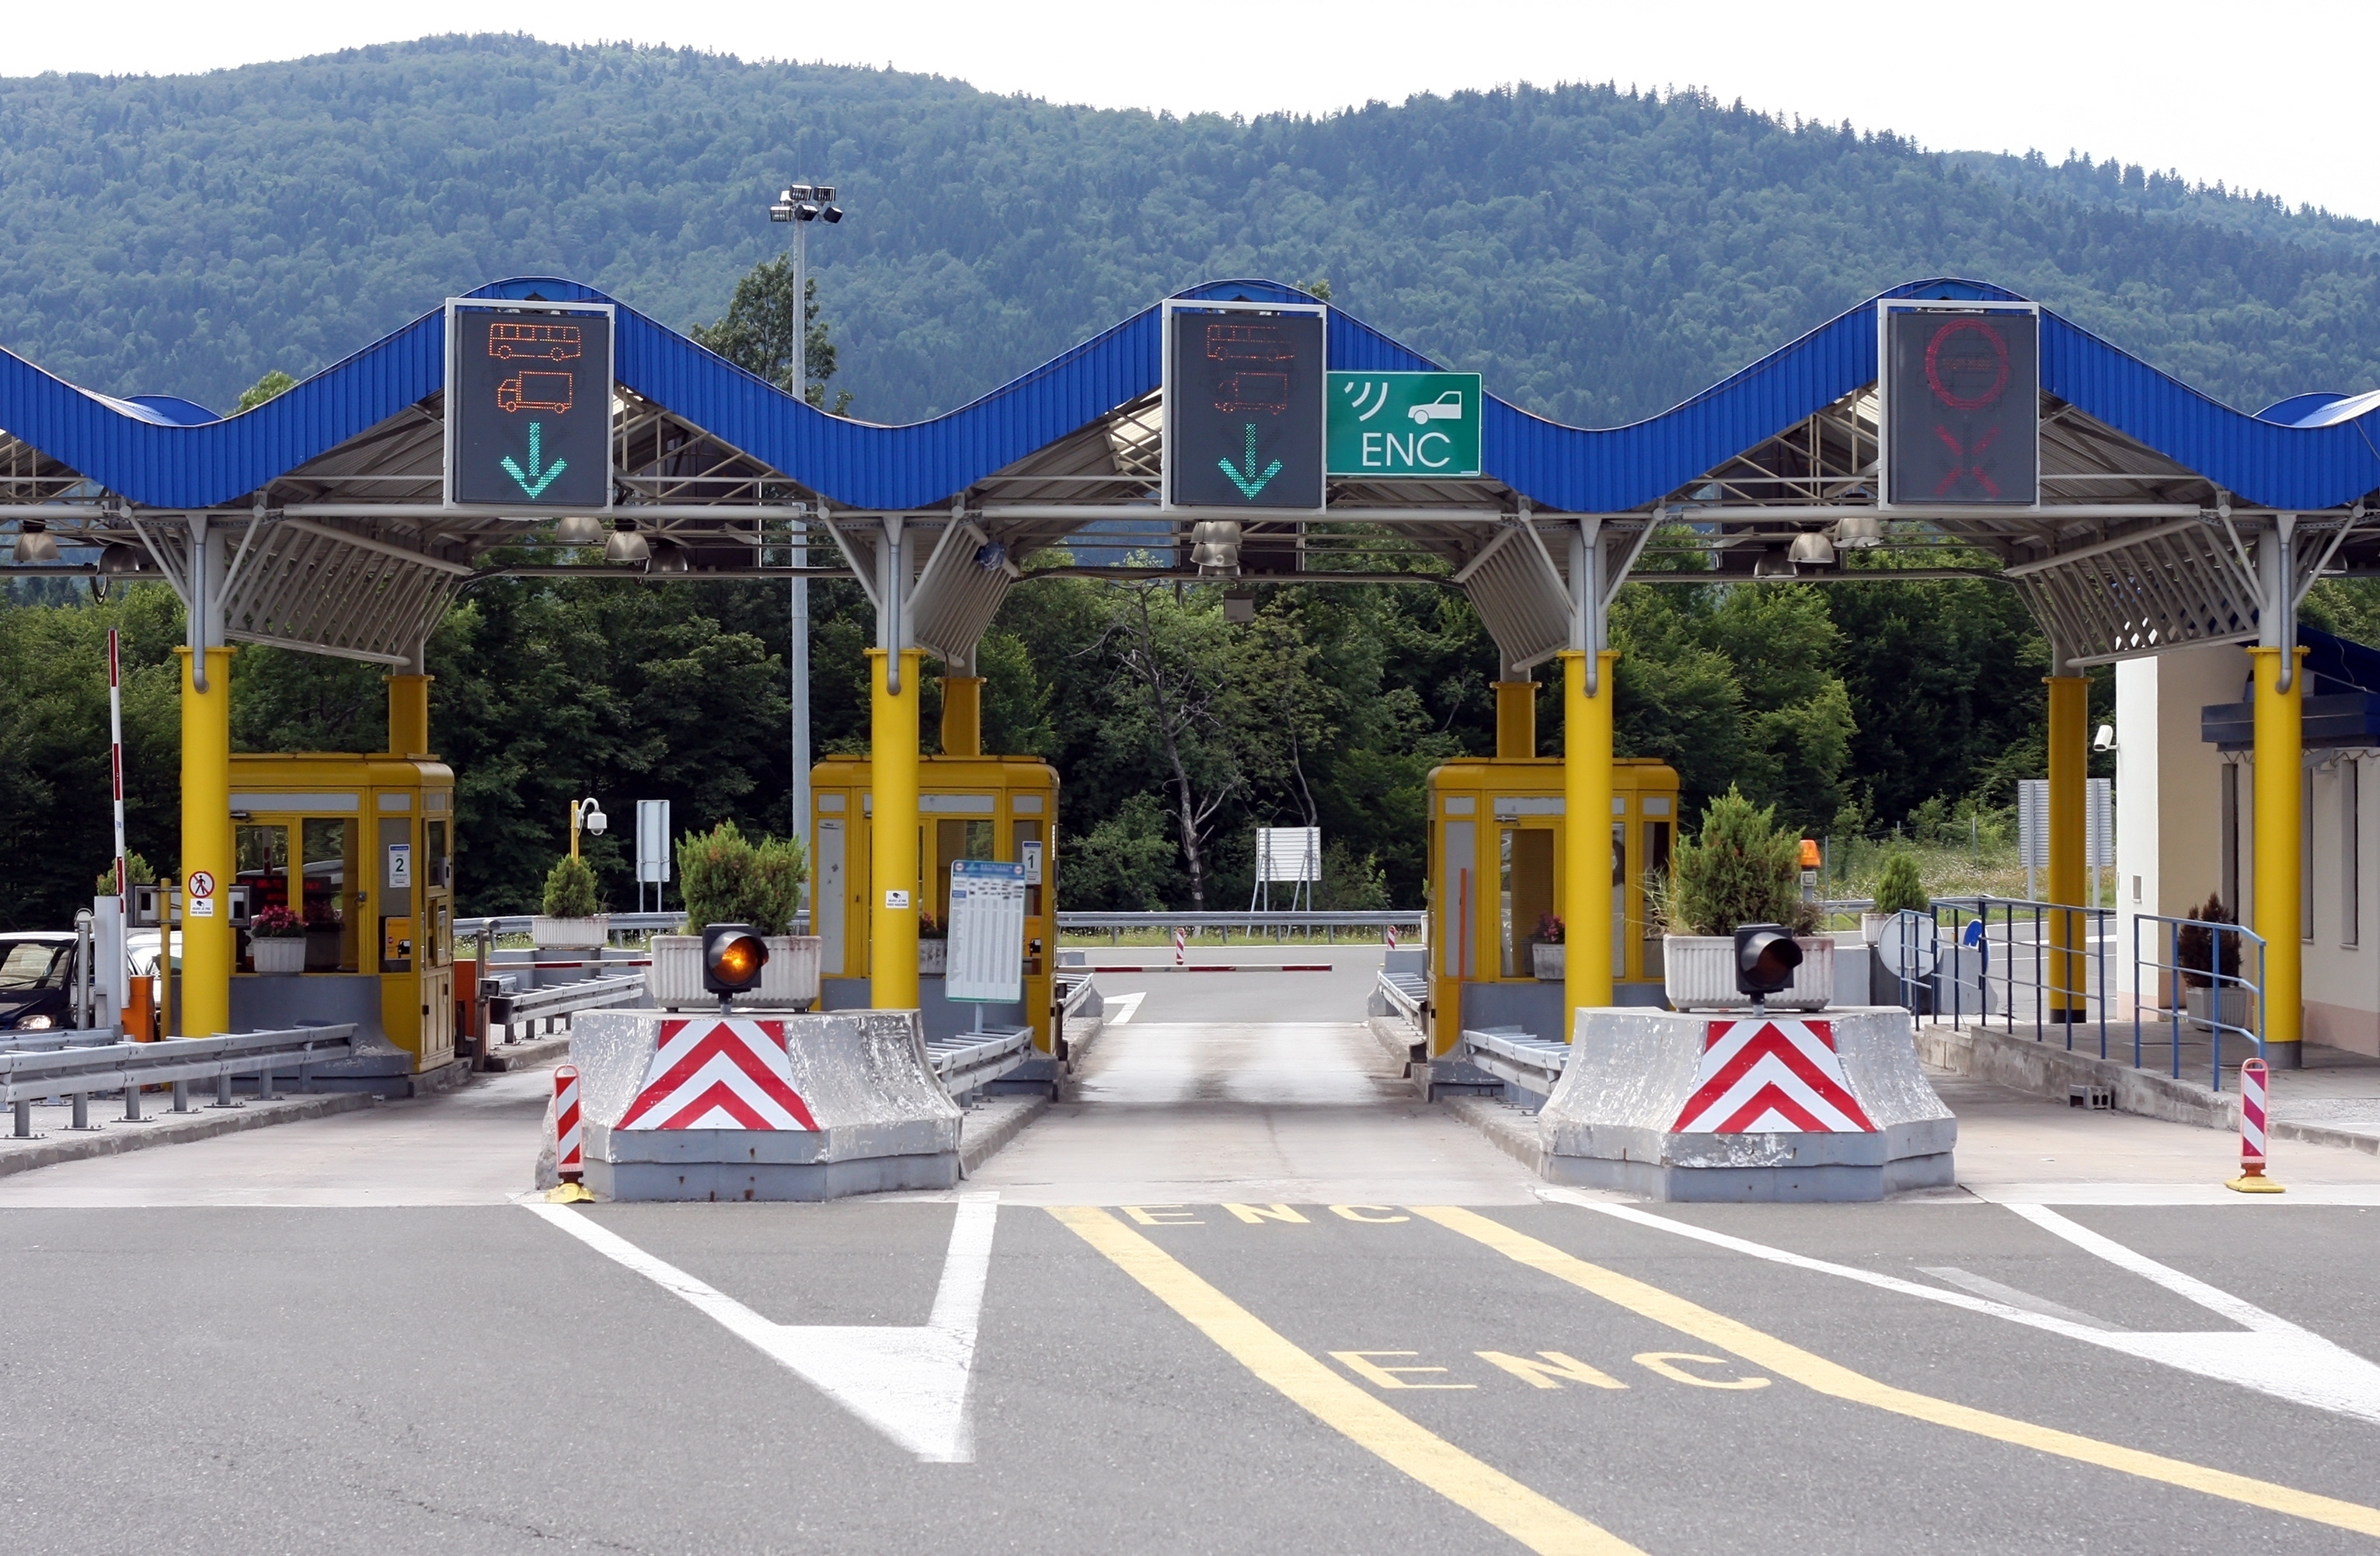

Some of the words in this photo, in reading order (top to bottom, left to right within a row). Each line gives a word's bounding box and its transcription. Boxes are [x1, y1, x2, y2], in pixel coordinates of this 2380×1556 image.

[1362, 431, 1451, 468] ENC
[396, 857, 404, 872] 2
[1028, 854, 1033, 869] 1
[1120, 1203, 1410, 1225] ENC
[1326, 1350, 1772, 1390] ENC
